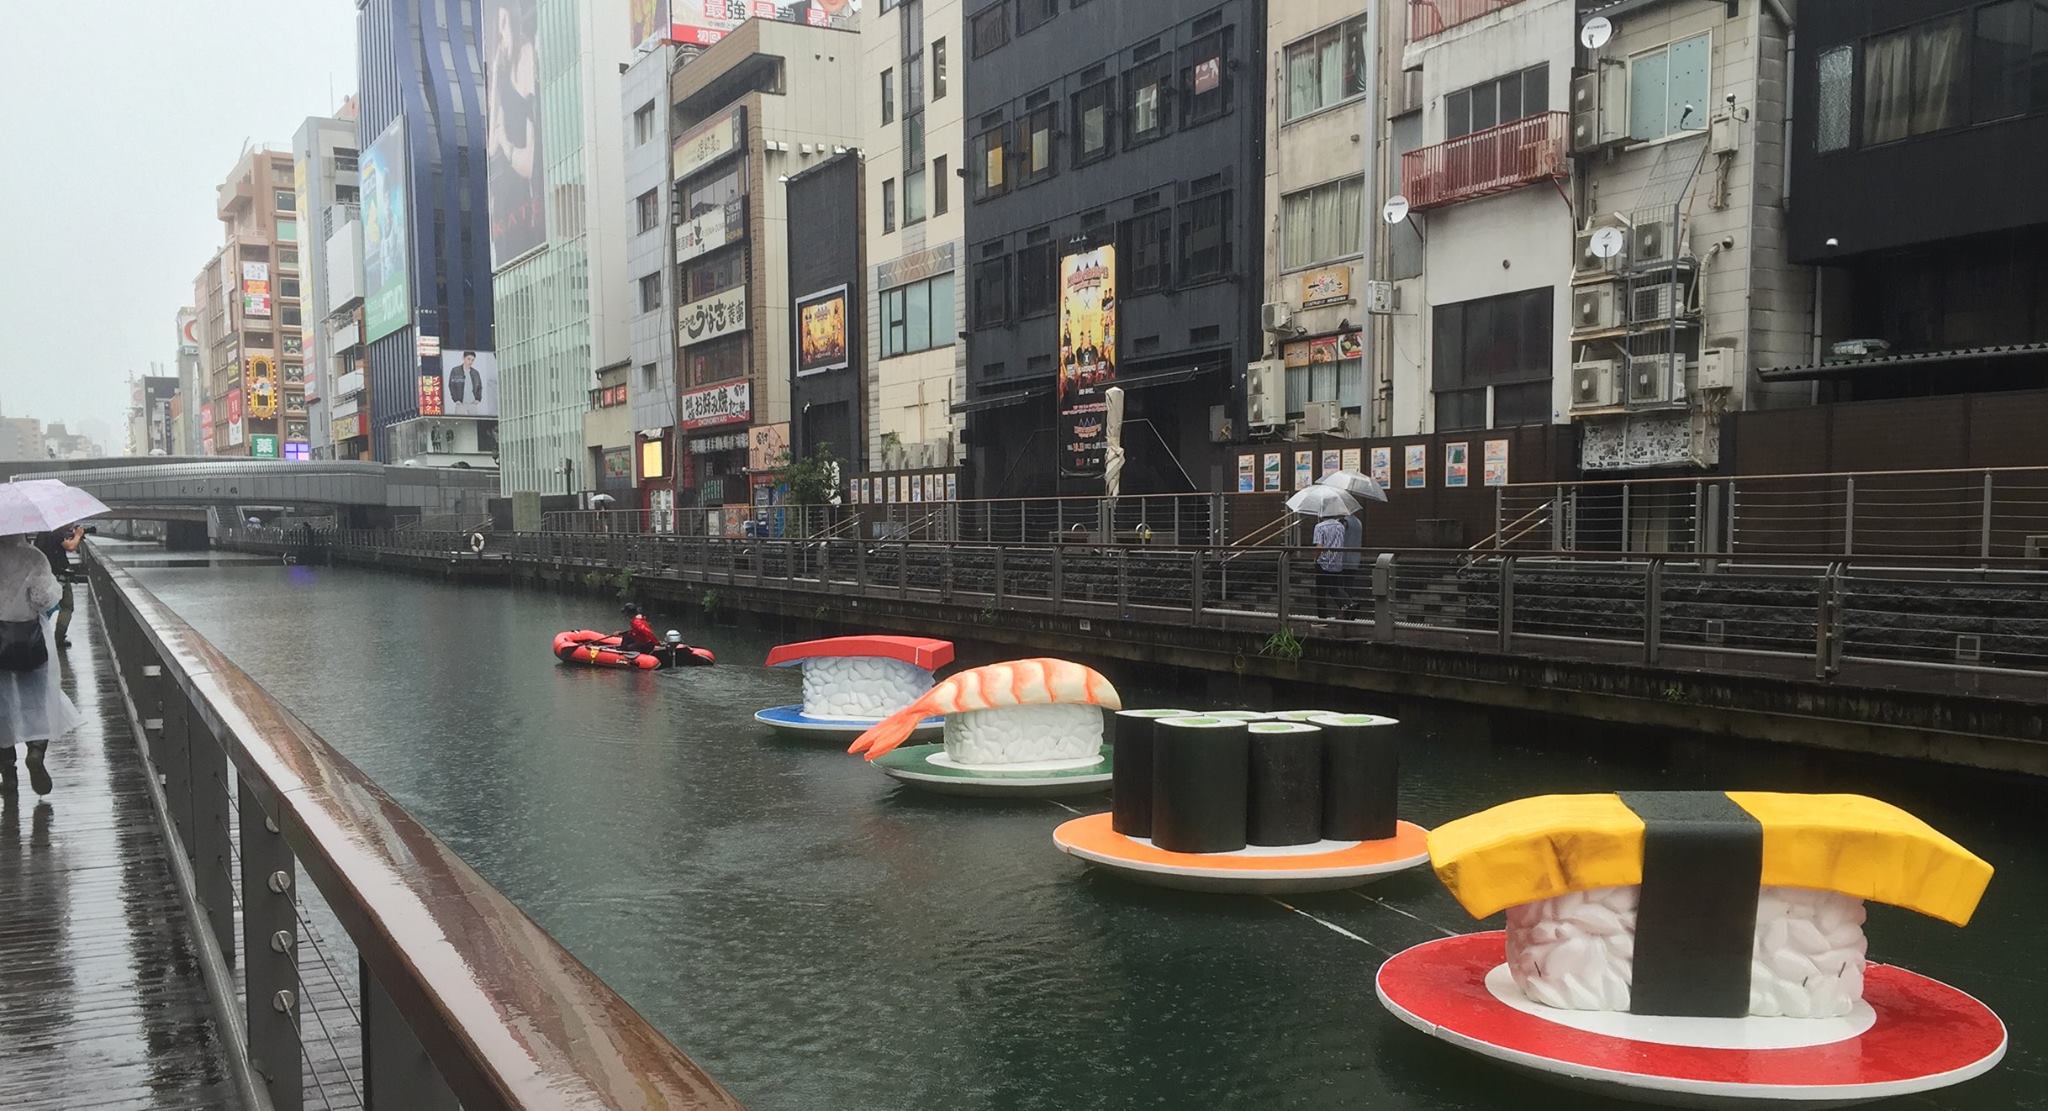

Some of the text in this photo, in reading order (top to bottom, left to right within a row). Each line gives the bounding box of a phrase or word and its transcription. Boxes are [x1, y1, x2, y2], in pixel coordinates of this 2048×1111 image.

[705, 0, 746, 20] 最強
[687, 299, 727, 339] うなぎ
[256, 438, 273, 454] 薬
